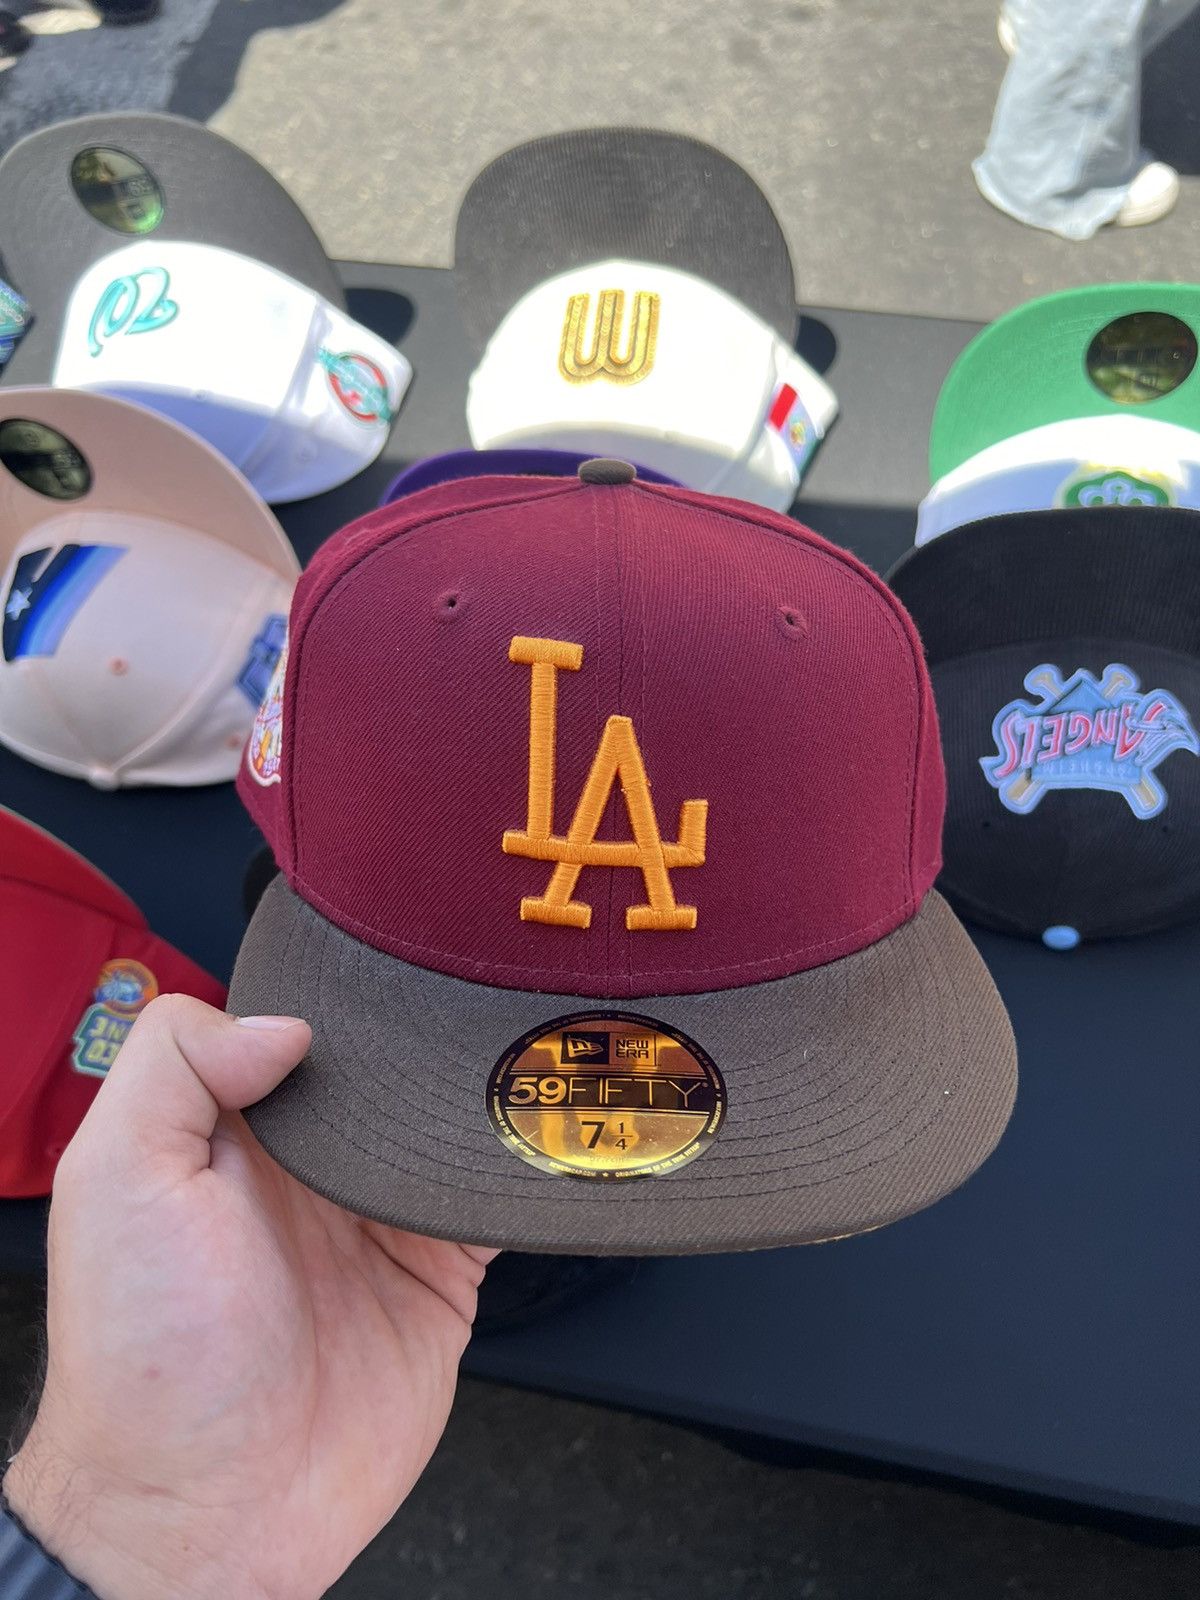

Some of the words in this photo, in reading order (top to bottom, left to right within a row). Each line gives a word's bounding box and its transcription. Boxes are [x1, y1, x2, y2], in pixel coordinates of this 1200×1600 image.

[993, 701, 1167, 779] ANGELS
[502, 635, 708, 931] LA
[616, 1040, 649, 1049] NEW
[616, 1049, 649, 1059] ERA
[507, 1076, 702, 1108] 59FIFTY
[581, 1121, 606, 1149] 7
